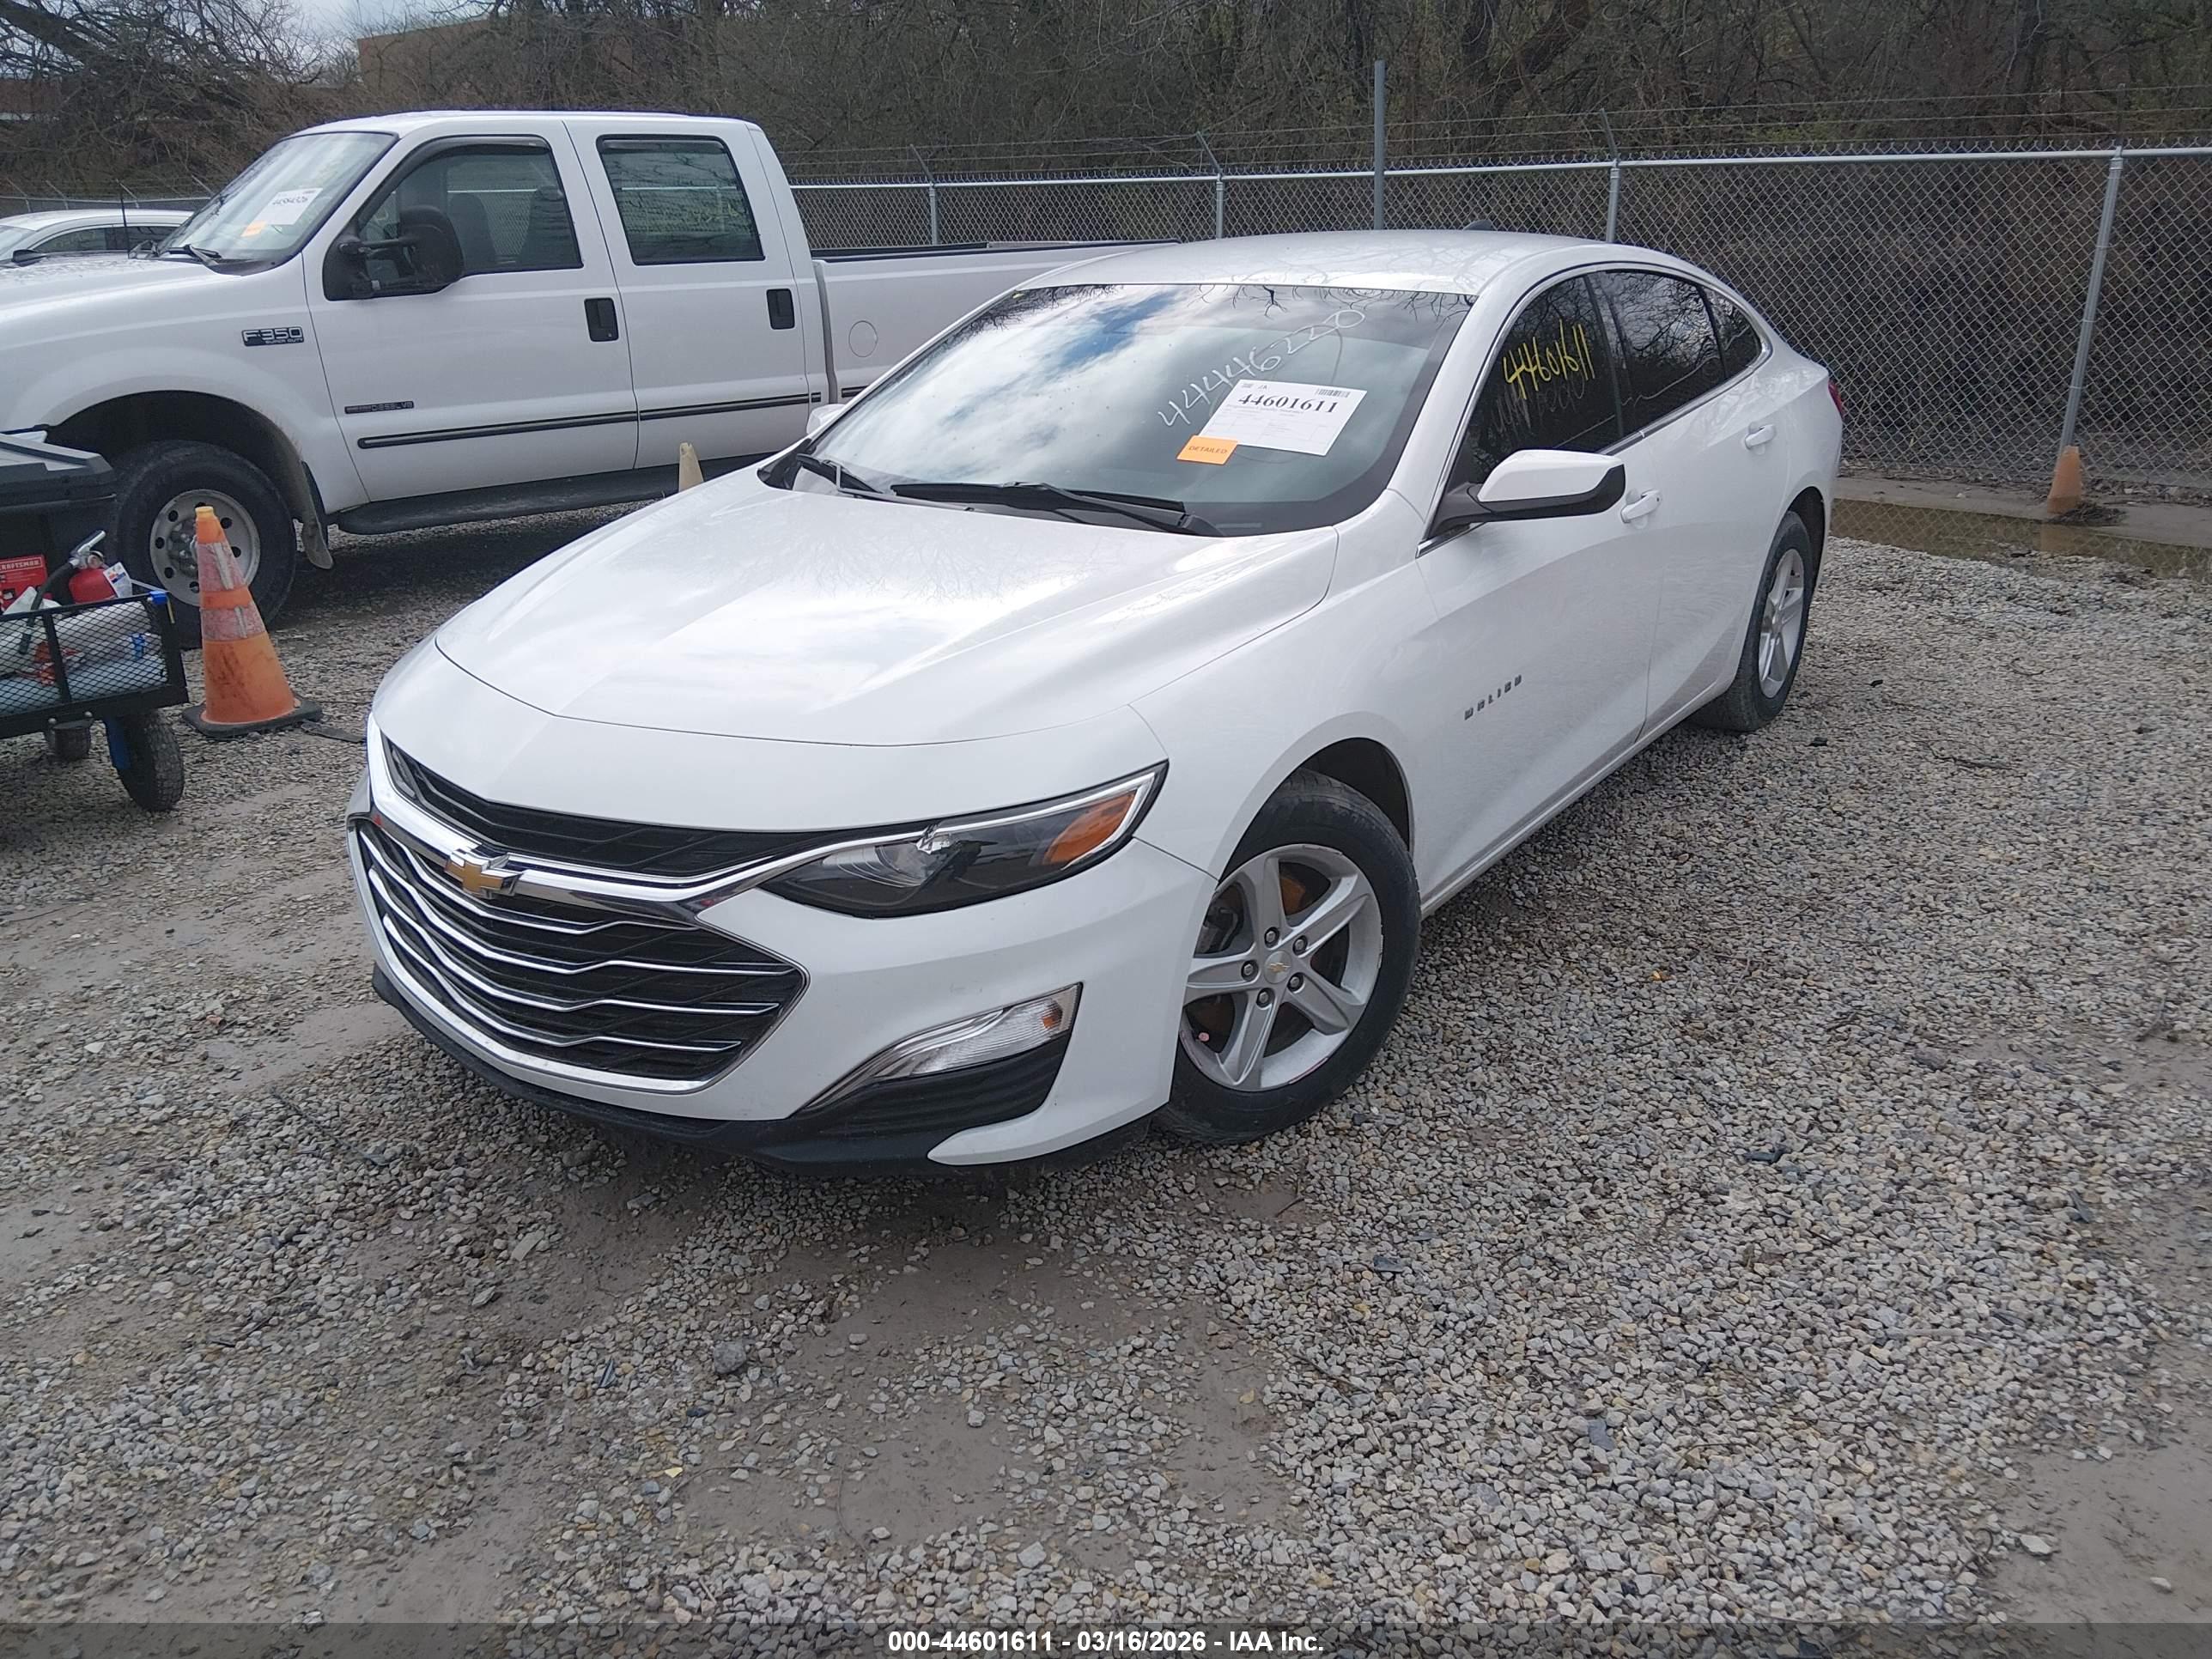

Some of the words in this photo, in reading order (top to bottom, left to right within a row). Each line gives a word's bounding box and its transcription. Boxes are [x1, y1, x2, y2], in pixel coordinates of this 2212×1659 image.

[1503, 319, 1595, 400] 44601611
[1238, 392, 1339, 414] 44601611
[1188, 446, 1228, 454] DETAILED
[0, 560, 40, 570] RAFTSMAN
[1464, 674, 1522, 720] MALIBU
